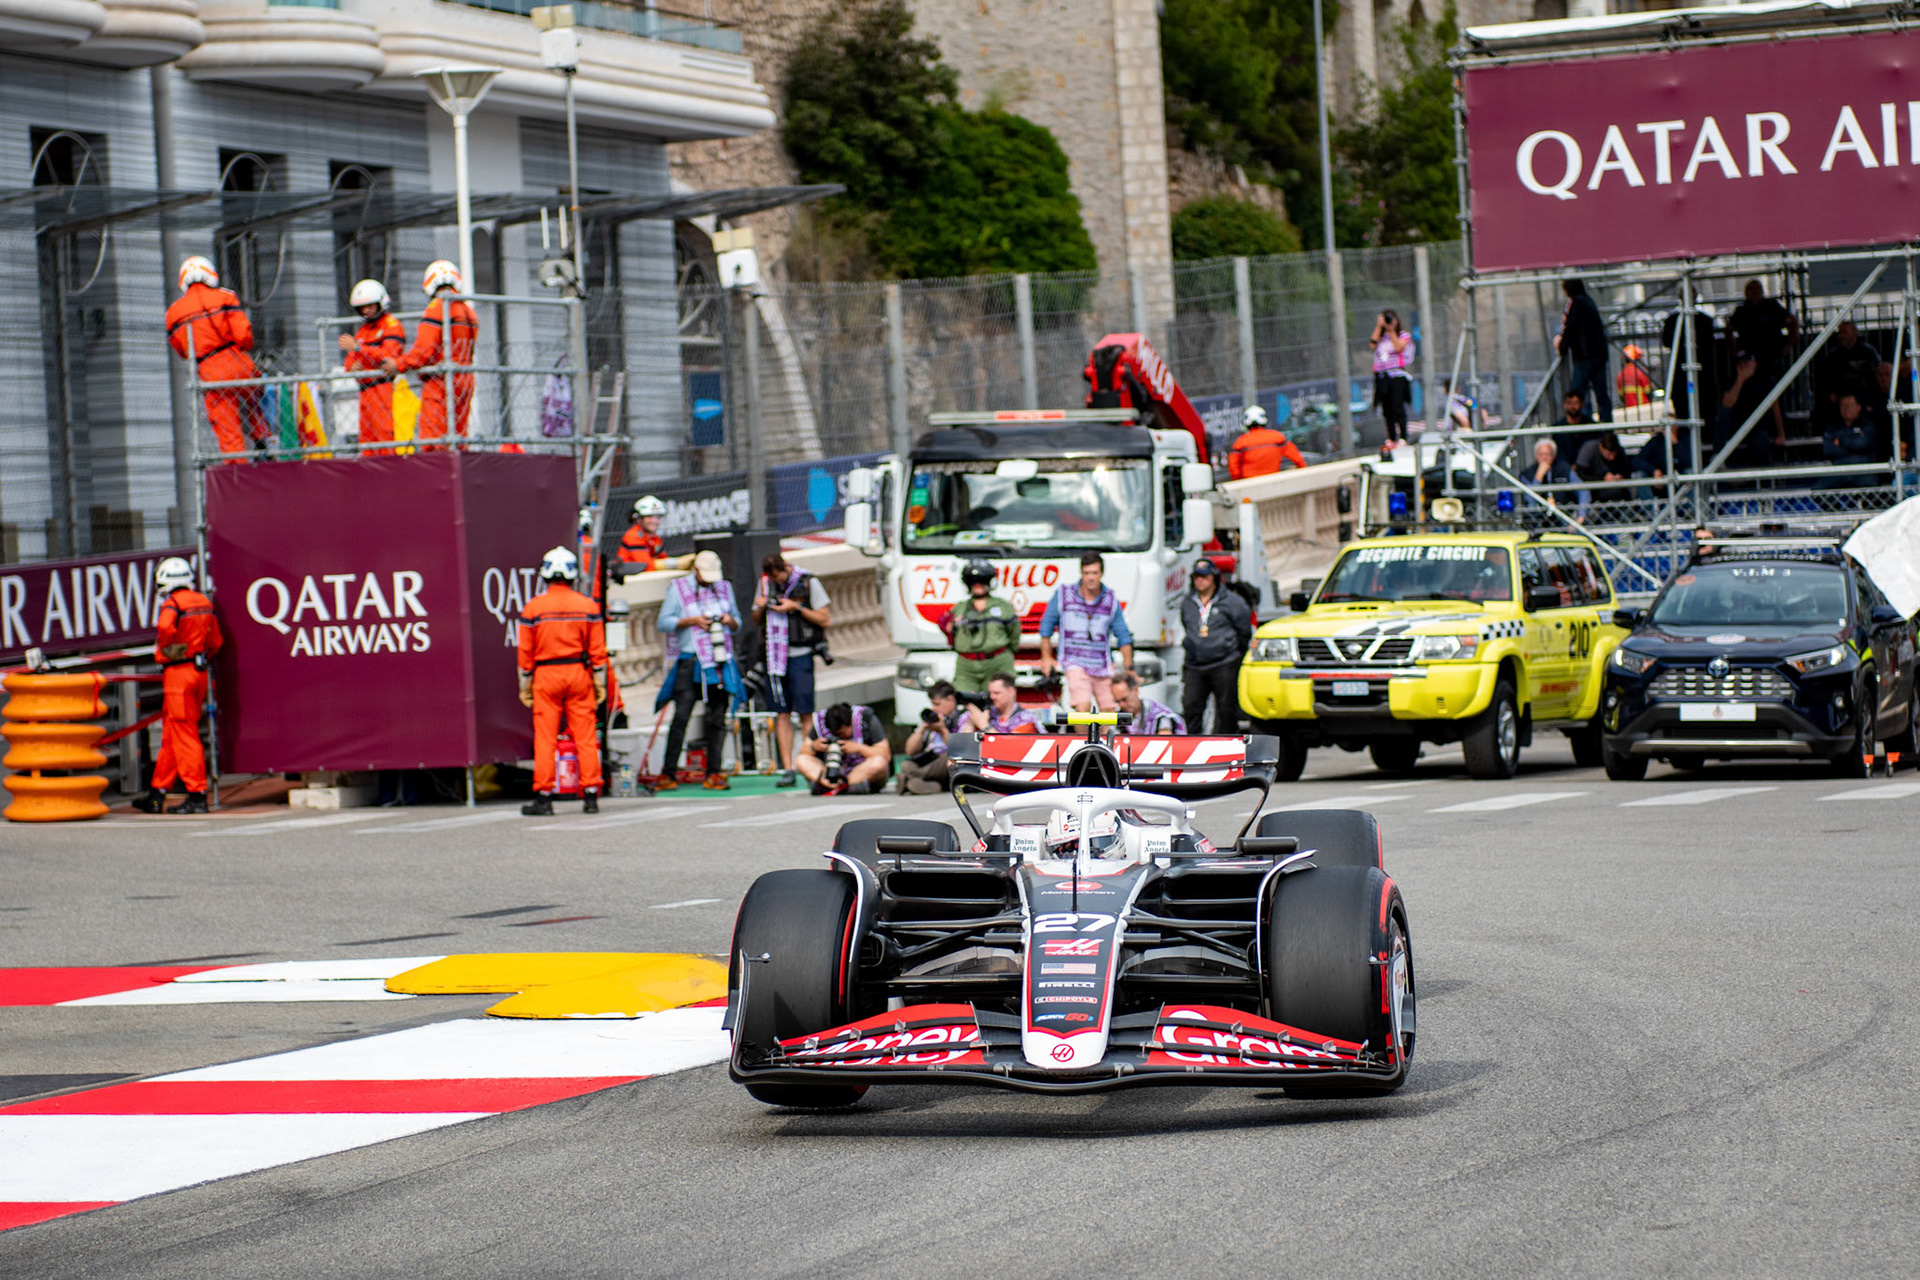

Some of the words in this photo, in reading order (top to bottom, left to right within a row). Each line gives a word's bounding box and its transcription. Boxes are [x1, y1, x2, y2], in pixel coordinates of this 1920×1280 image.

[1515, 111, 1799, 201] QATAR
[1819, 101, 1920, 172] AI
[1426, 546, 1488, 561] CIRCUIT
[922, 578, 951, 599] A7
[995, 564, 1060, 589] ILLO
[246, 570, 429, 635] QATAR
[482, 567, 548, 625] QAT
[0, 574, 32, 648] R
[290, 621, 432, 658] AIRWAYS
[1014, 838, 1035, 846] Palm
[1146, 839, 1167, 847] Palm
[1033, 913, 1116, 933] 27
